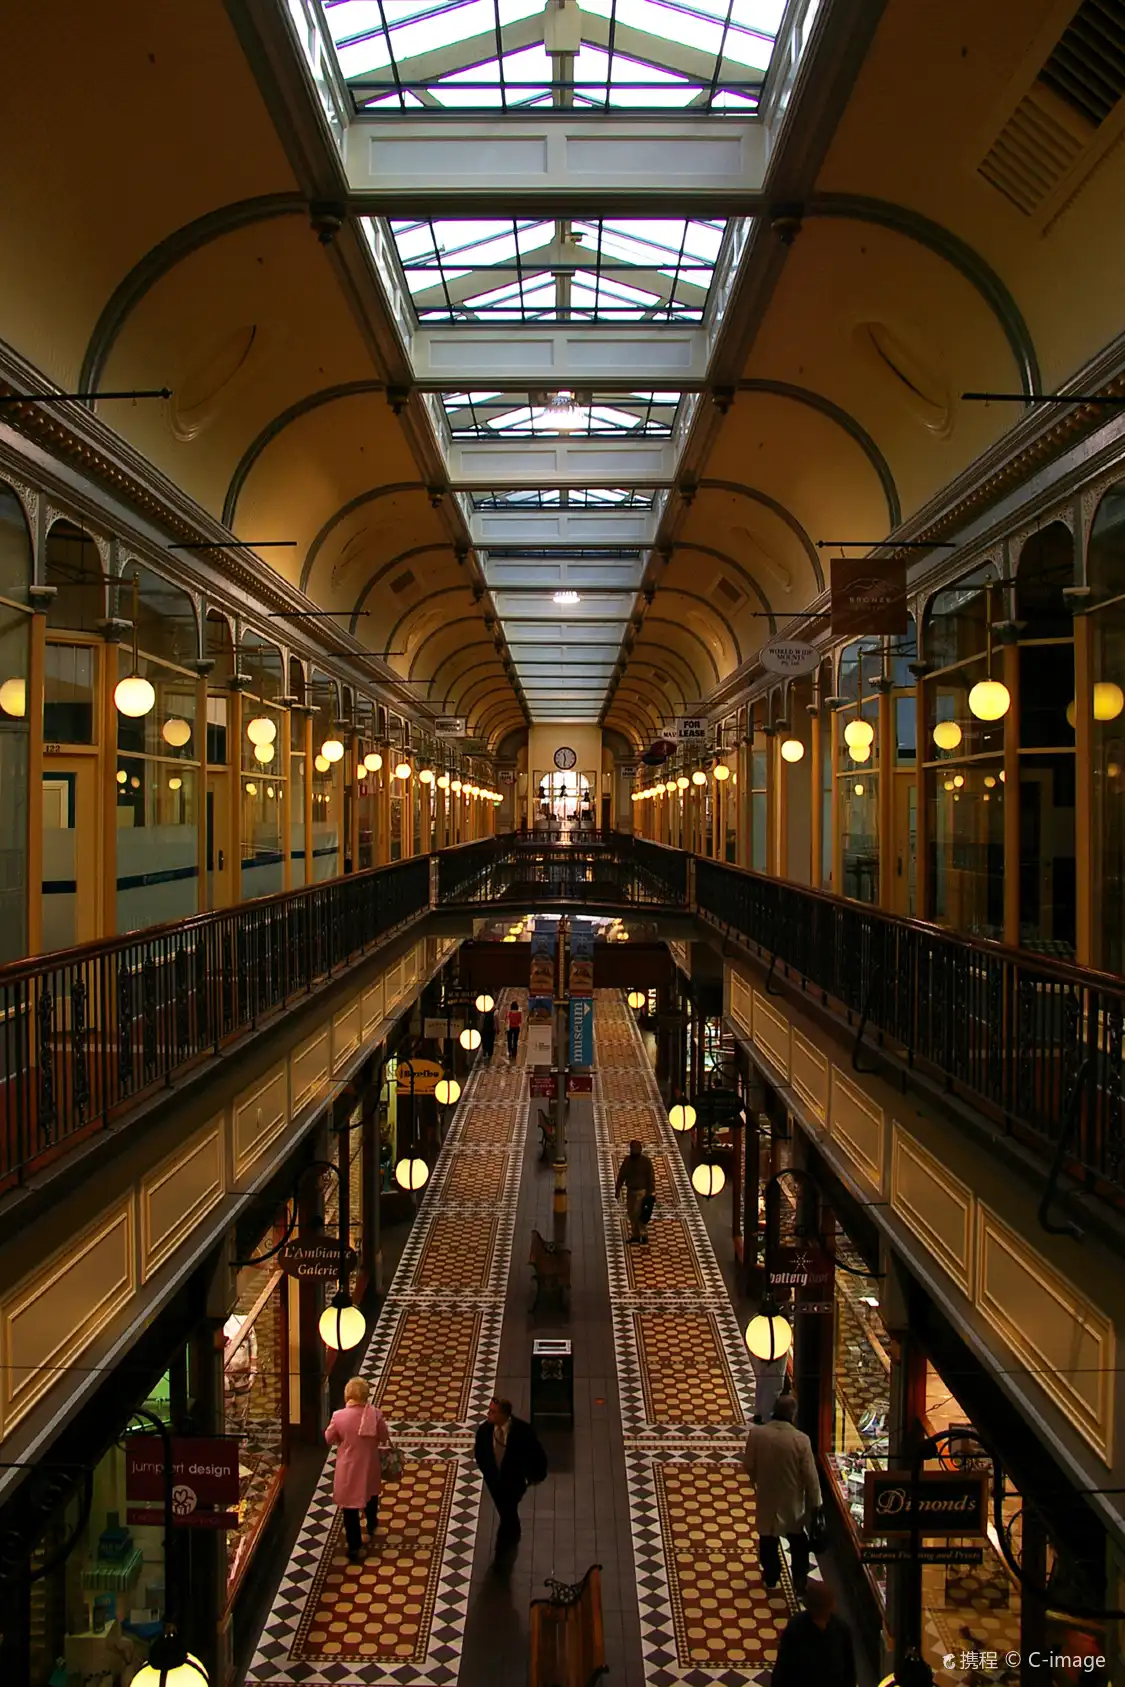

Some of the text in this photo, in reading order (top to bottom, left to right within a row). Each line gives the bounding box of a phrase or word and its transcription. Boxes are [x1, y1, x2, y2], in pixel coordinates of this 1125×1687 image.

[683, 720, 700, 729] FOR
[678, 729, 705, 737] LEASE
[573, 1001, 583, 1063] museum
[284, 1246, 352, 1259] L'Ambiane
[297, 1262, 339, 1276] Galerie
[188, 1463, 231, 1478] design
